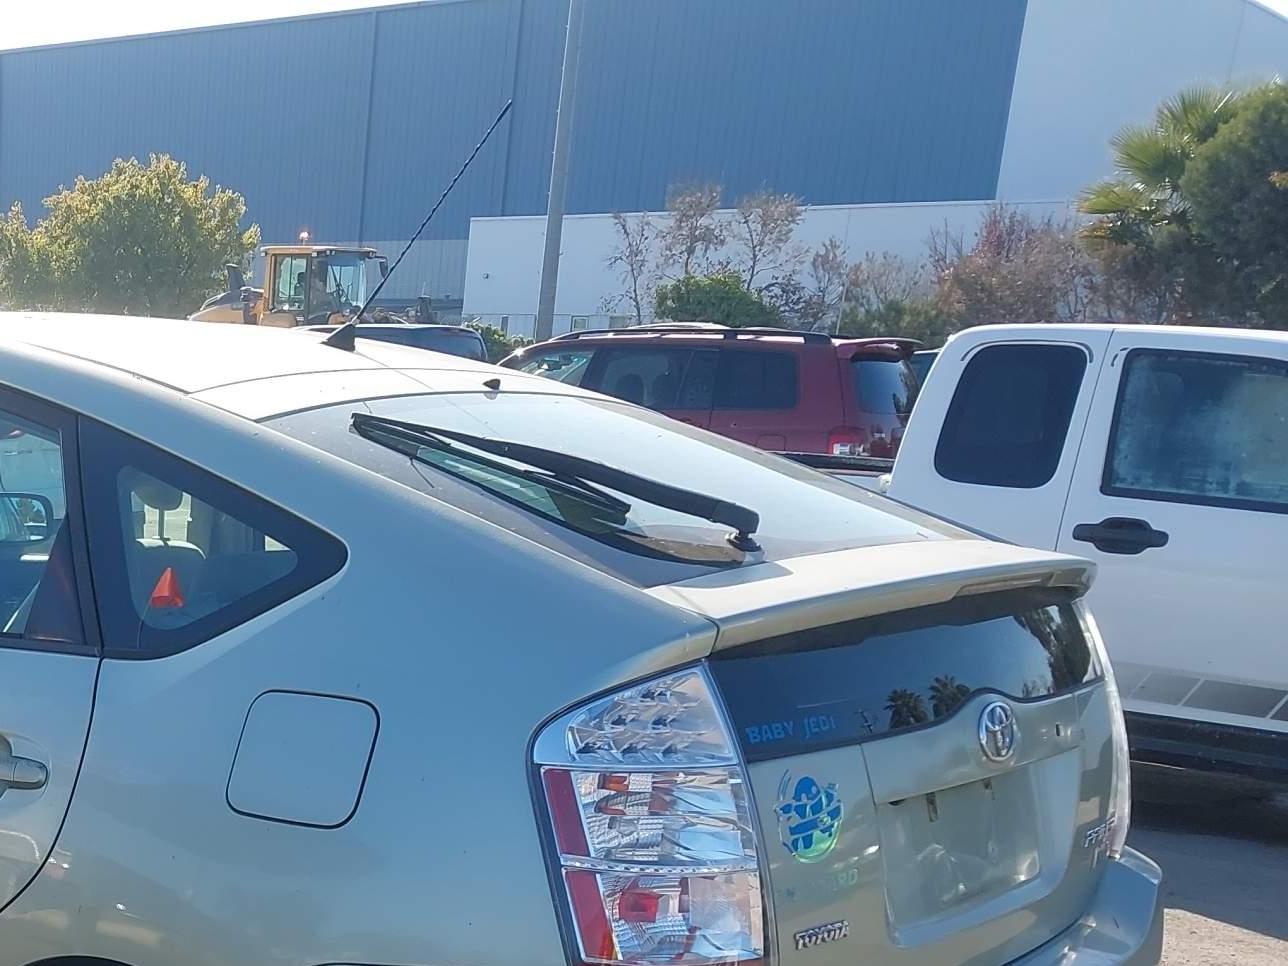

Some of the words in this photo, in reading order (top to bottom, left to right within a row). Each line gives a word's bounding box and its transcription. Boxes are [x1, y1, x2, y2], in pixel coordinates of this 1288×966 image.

[746, 720, 793, 744] BABY
[803, 715, 838, 740] JEDI
[794, 920, 849, 950] TOYOTA
